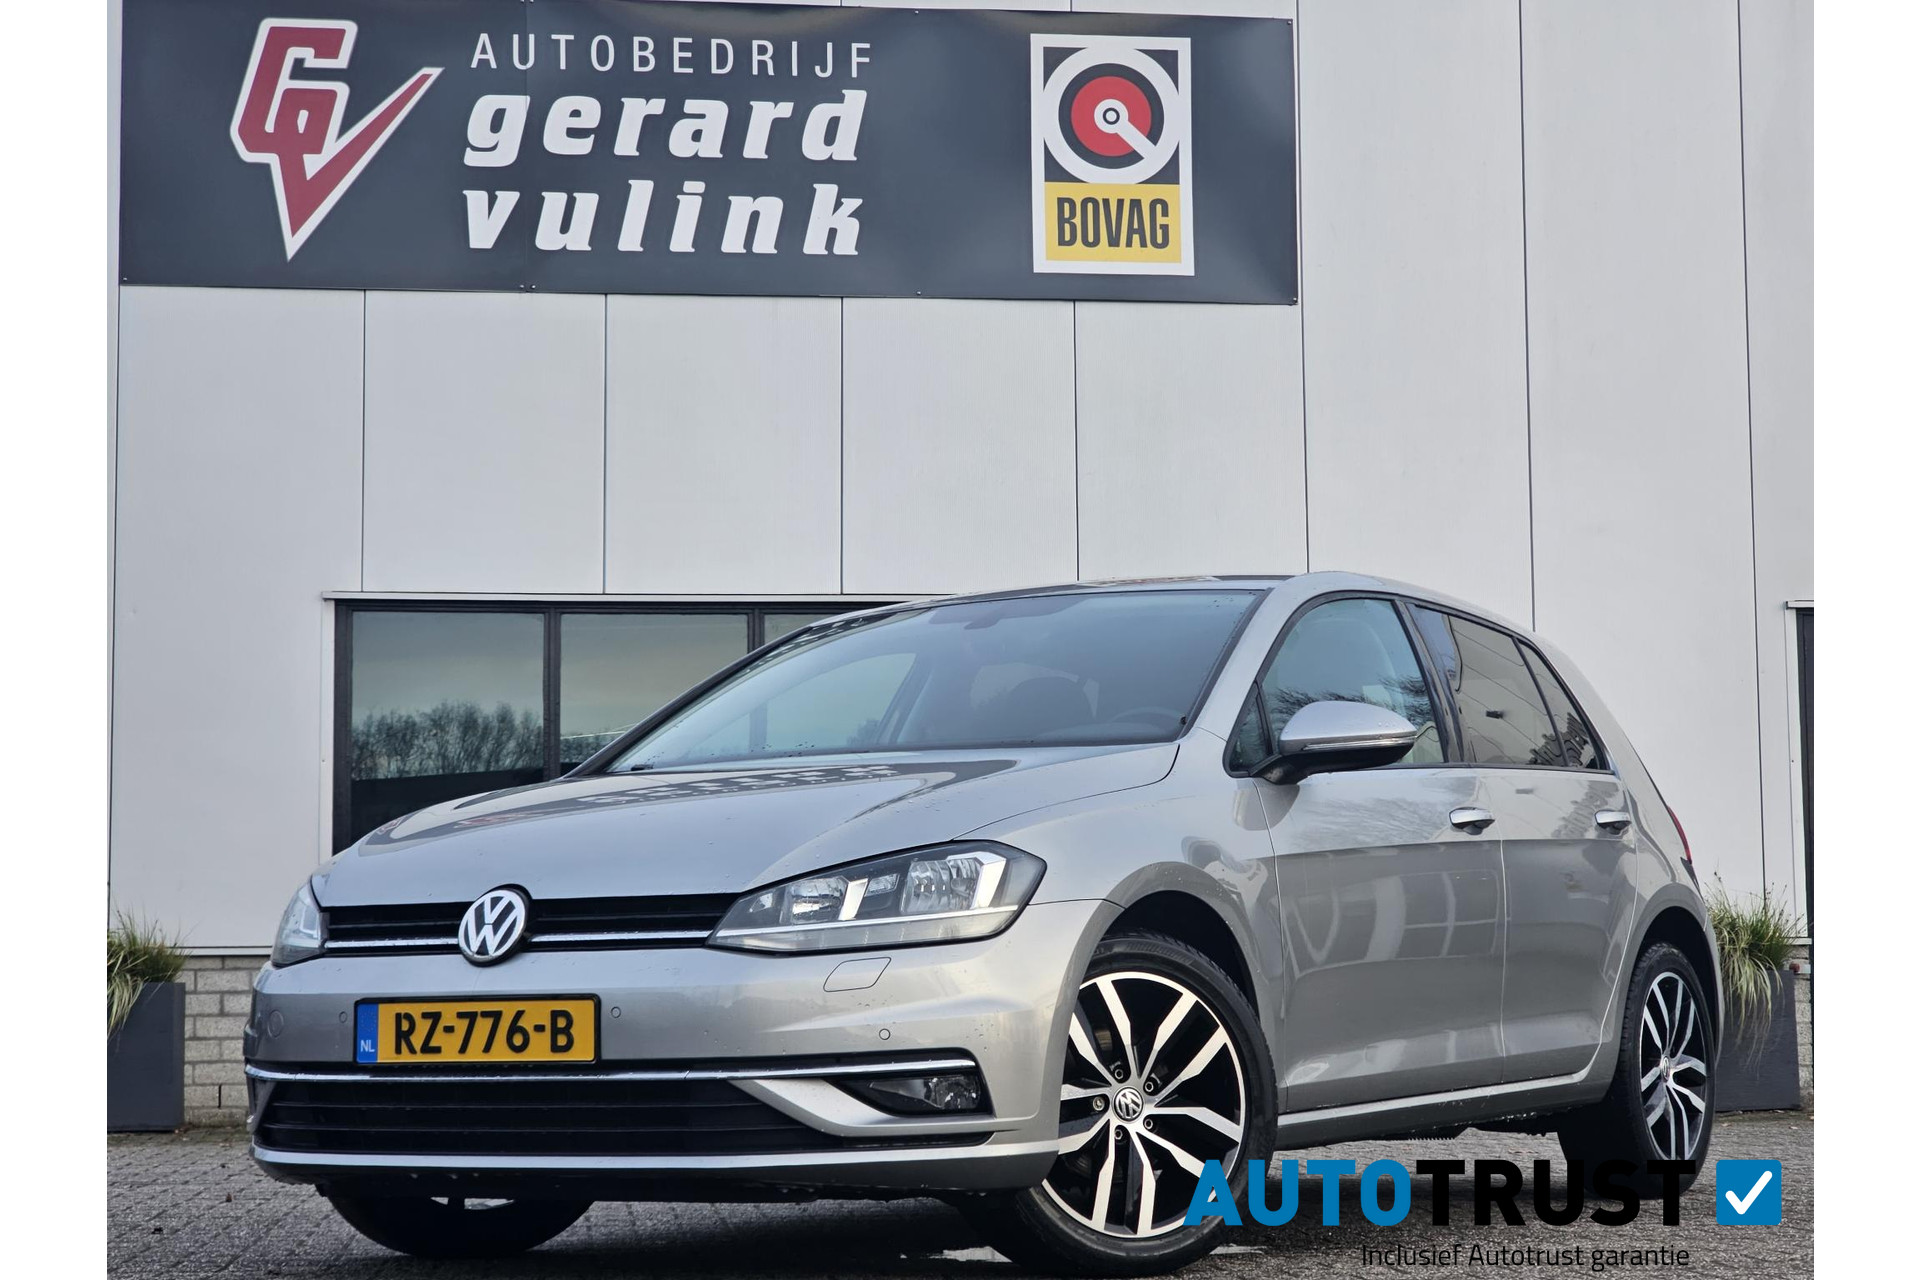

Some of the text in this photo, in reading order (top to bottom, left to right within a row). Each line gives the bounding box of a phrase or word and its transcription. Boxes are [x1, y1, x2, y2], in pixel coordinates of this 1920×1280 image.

[470, 33, 871, 79] AUTOBEDRIJF
[463, 89, 868, 168] gerard
[462, 179, 864, 256] vulink
[1056, 196, 1170, 250] BOVAG
[360, 1039, 375, 1053] NL
[394, 1009, 574, 1055] RZ-776-B
